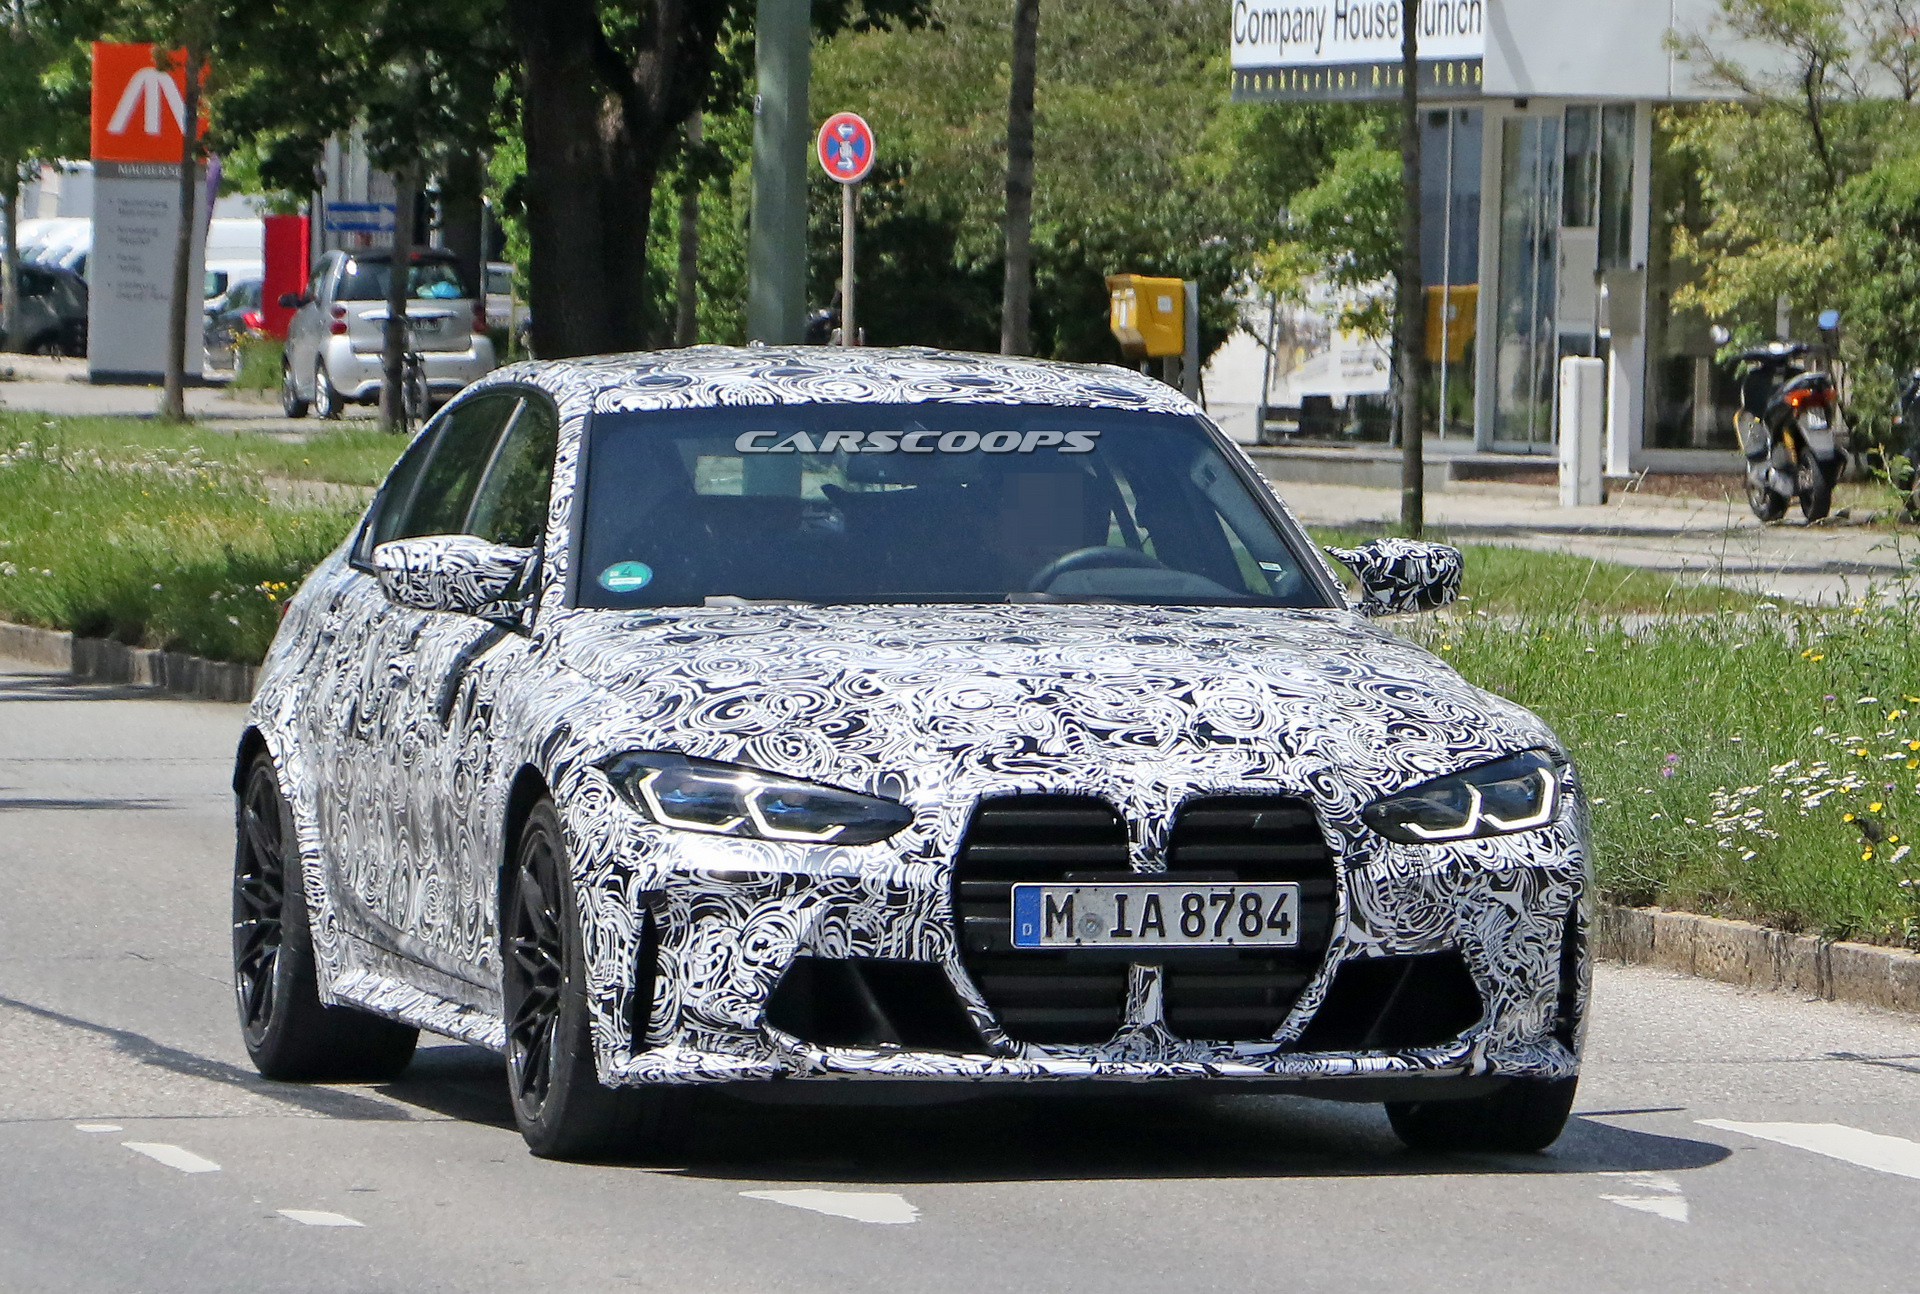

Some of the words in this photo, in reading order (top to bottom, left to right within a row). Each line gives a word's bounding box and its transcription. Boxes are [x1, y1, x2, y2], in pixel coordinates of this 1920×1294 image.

[1234, 0, 1326, 55] Company
[1334, 0, 1398, 41] House
[1417, 0, 1482, 36] unich
[1372, 64, 1404, 88] Rin
[1021, 922, 1033, 936] D
[1045, 893, 1074, 938] M
